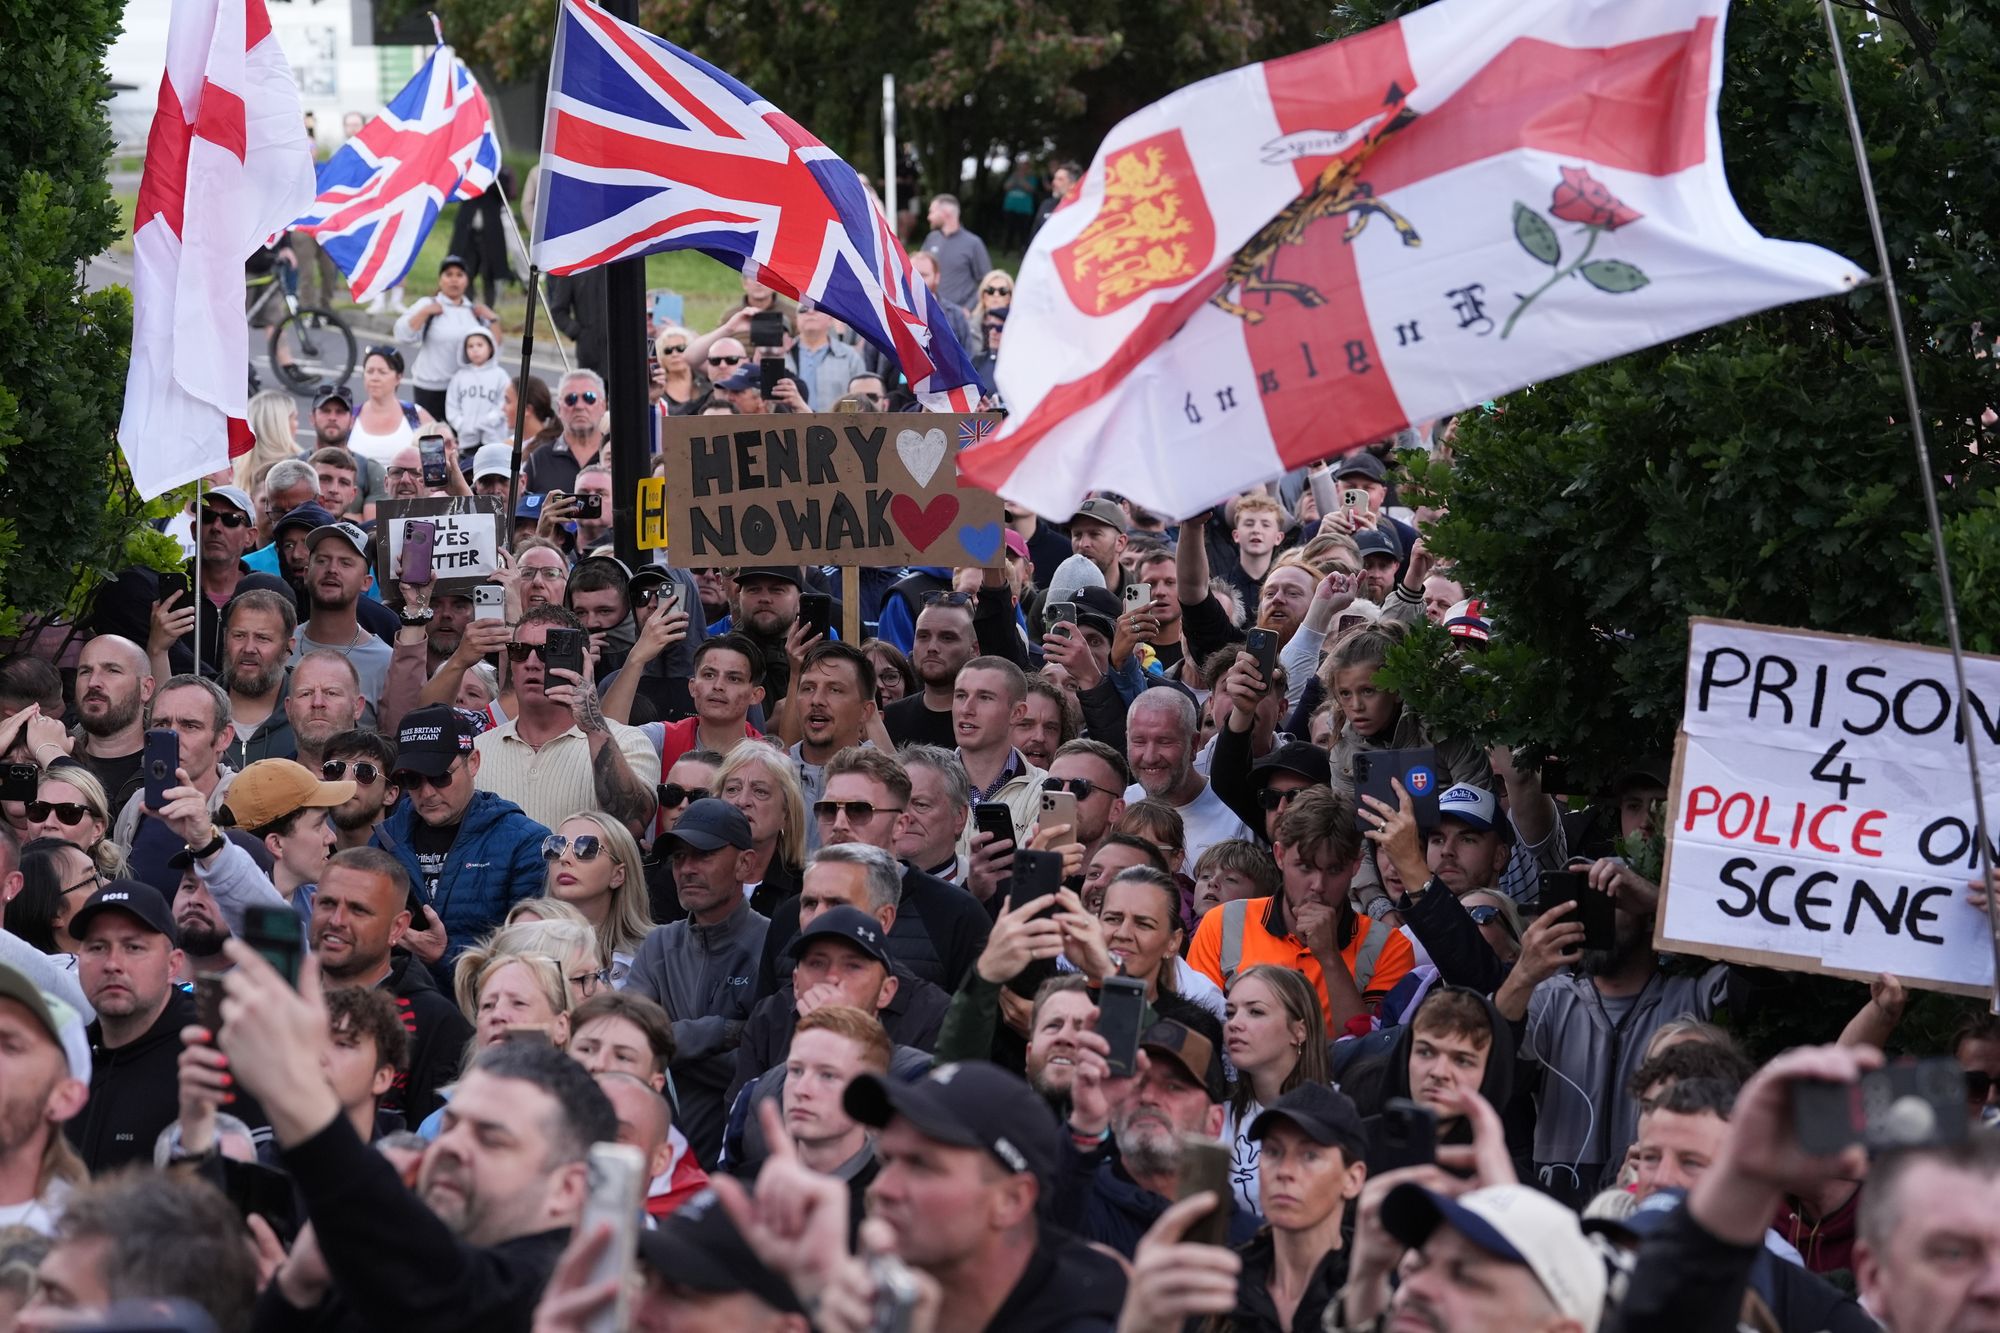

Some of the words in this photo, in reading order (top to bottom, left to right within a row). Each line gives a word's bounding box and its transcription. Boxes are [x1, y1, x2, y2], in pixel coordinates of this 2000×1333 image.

[690, 426, 887, 498] HENRY
[424, 518, 458, 530] LL
[690, 488, 894, 556] NOWAK
[433, 531, 470, 546] VES
[431, 549, 480, 570] TTER
[1698, 647, 2000, 745] PRISON
[400, 734, 417, 743] GREAT
[417, 733, 440, 741] AGAIN
[401, 728, 414, 736] MAKE
[414, 726, 442, 734] BRITAIN
[1810, 738, 1866, 800] 4
[1684, 785, 1888, 857] POLICE
[102, 892, 129, 902] BOSS
[1716, 857, 1952, 945] SCENE
[116, 1133, 134, 1141] BOSS
